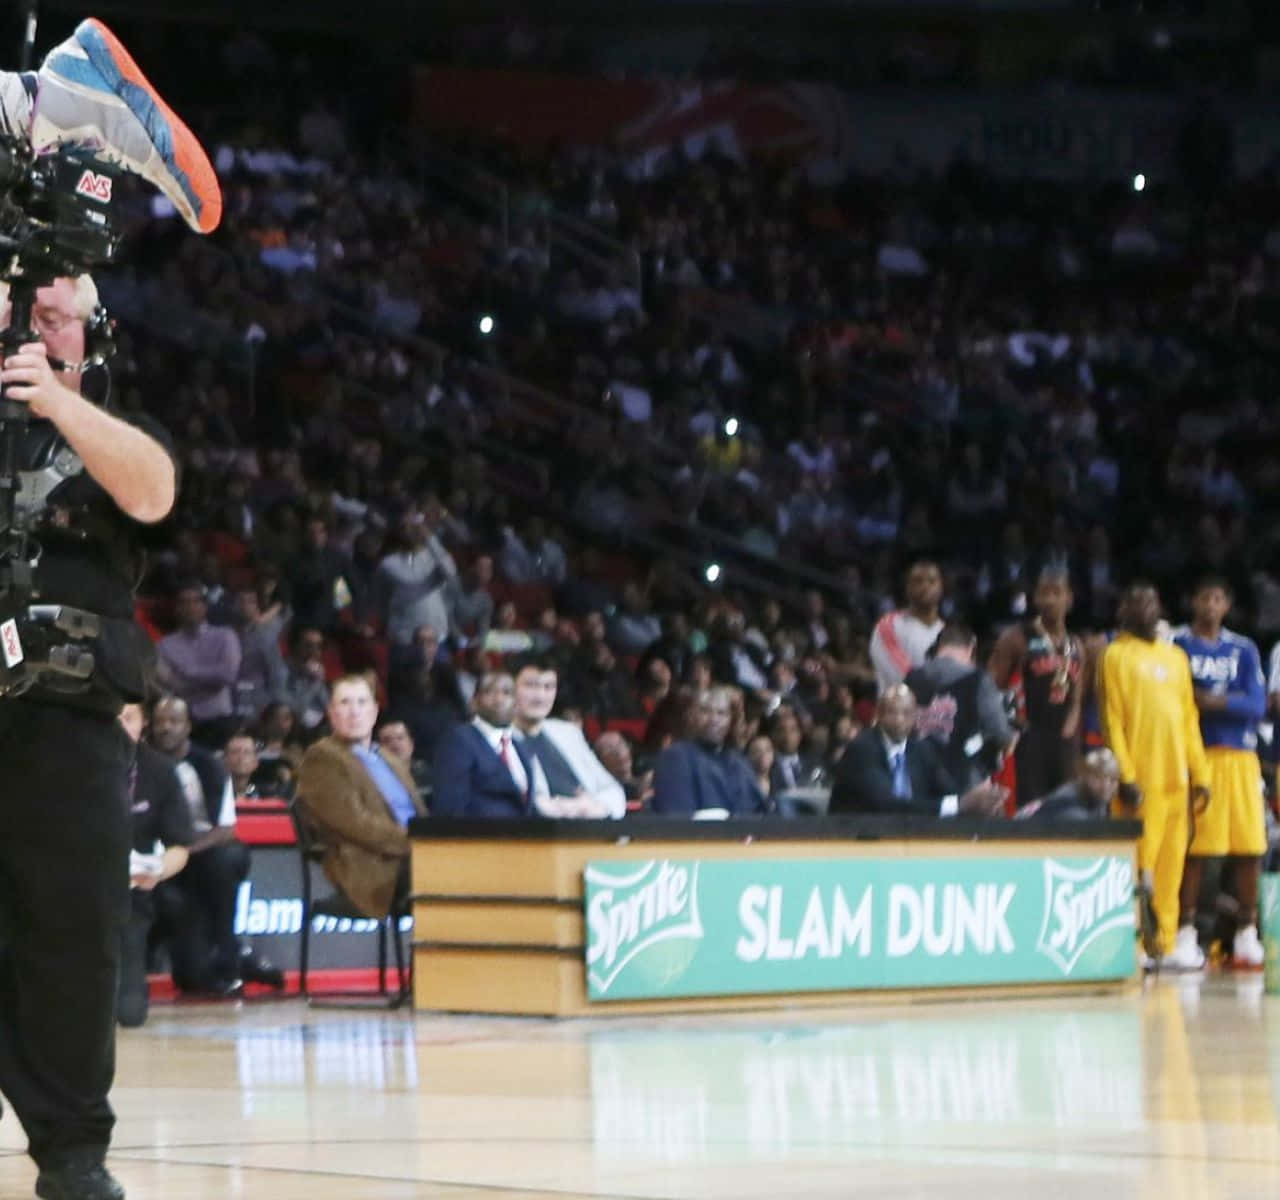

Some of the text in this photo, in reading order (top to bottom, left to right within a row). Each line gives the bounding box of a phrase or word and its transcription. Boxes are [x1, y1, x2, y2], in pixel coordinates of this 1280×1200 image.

[586, 857, 1134, 969] Sprite SLAM DUNK Sprite
